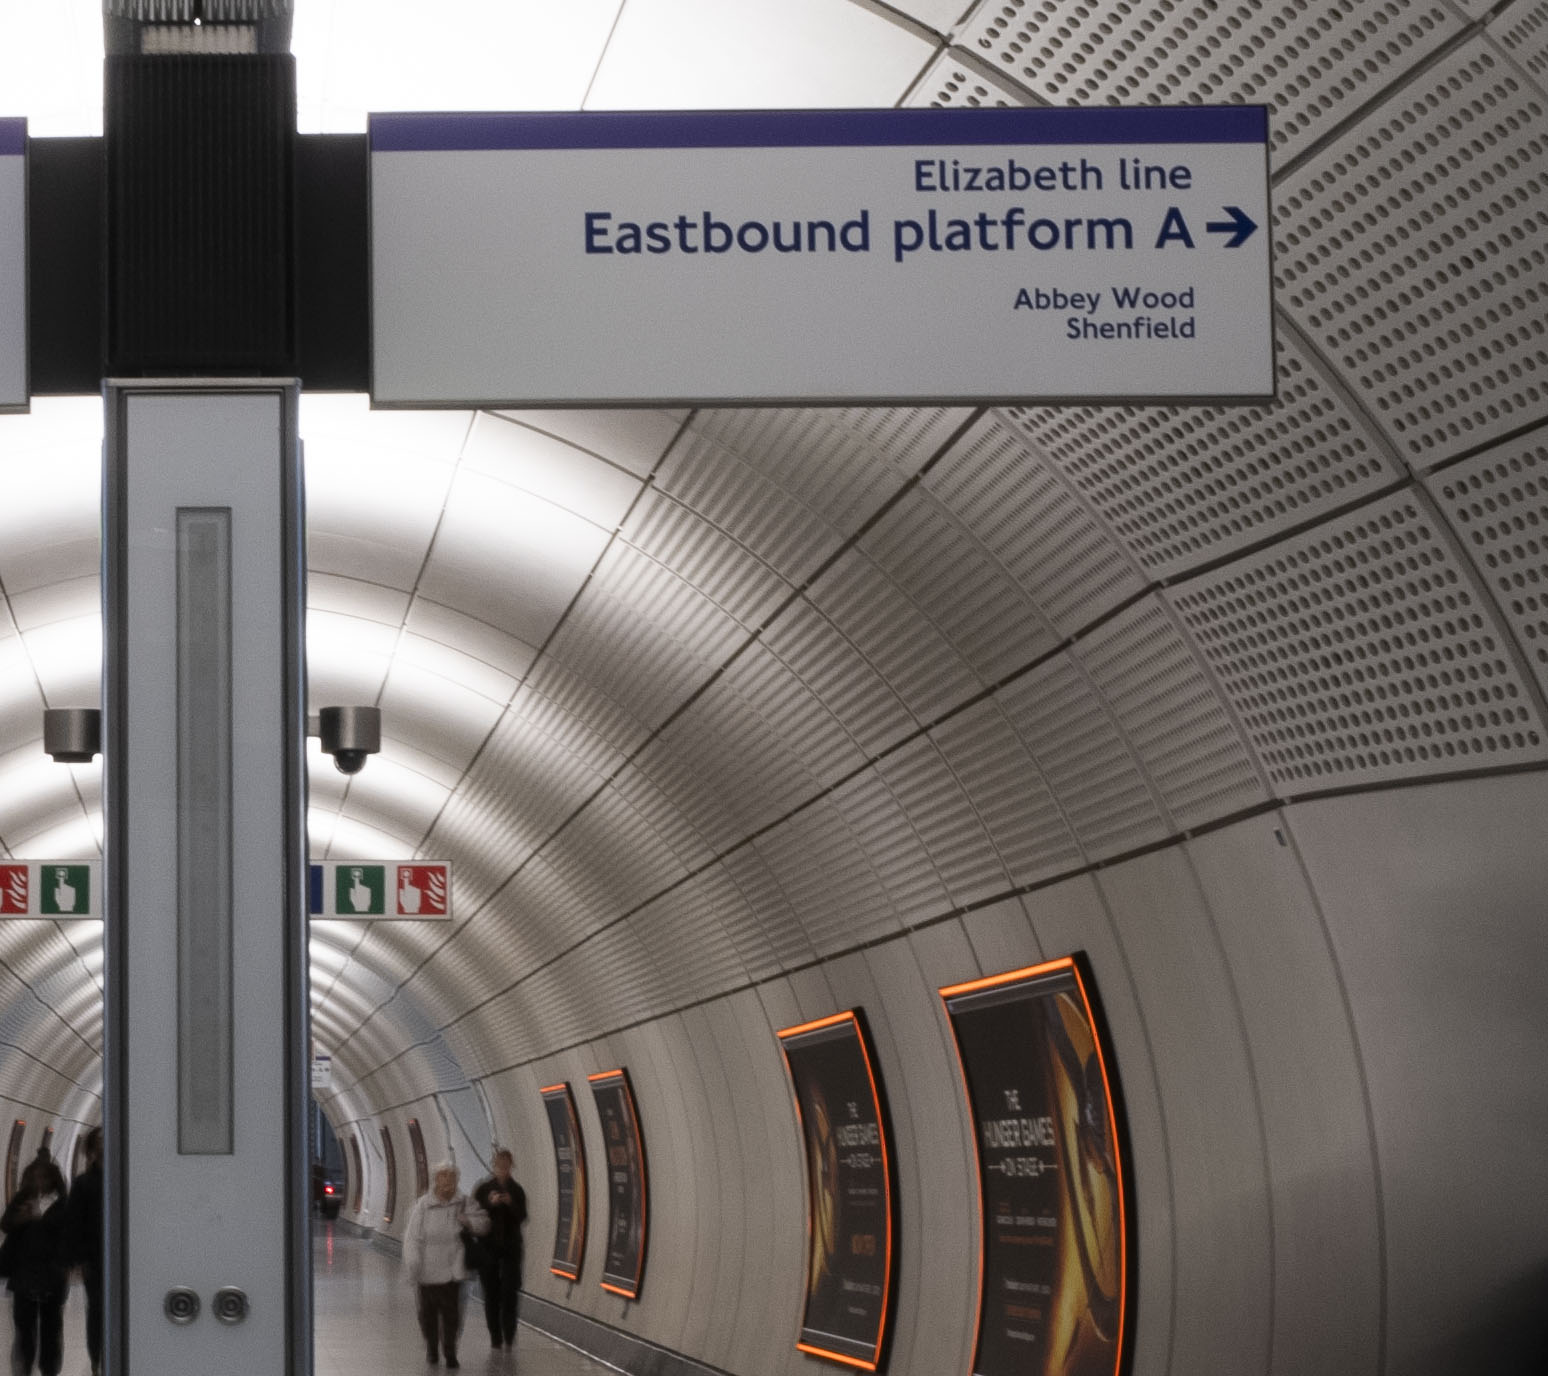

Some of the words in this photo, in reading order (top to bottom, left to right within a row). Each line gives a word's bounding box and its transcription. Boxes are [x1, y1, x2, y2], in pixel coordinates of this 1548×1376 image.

[914, 158, 1102, 191] Elizabeth
[1119, 157, 1192, 190] line
[584, 209, 869, 254] Eastbound
[894, 206, 1133, 262] platform
[1154, 206, 1195, 249] A
[1013, 287, 1101, 315] Abbey
[1111, 286, 1195, 310] Wood
[1066, 316, 1195, 340] Shenfield
